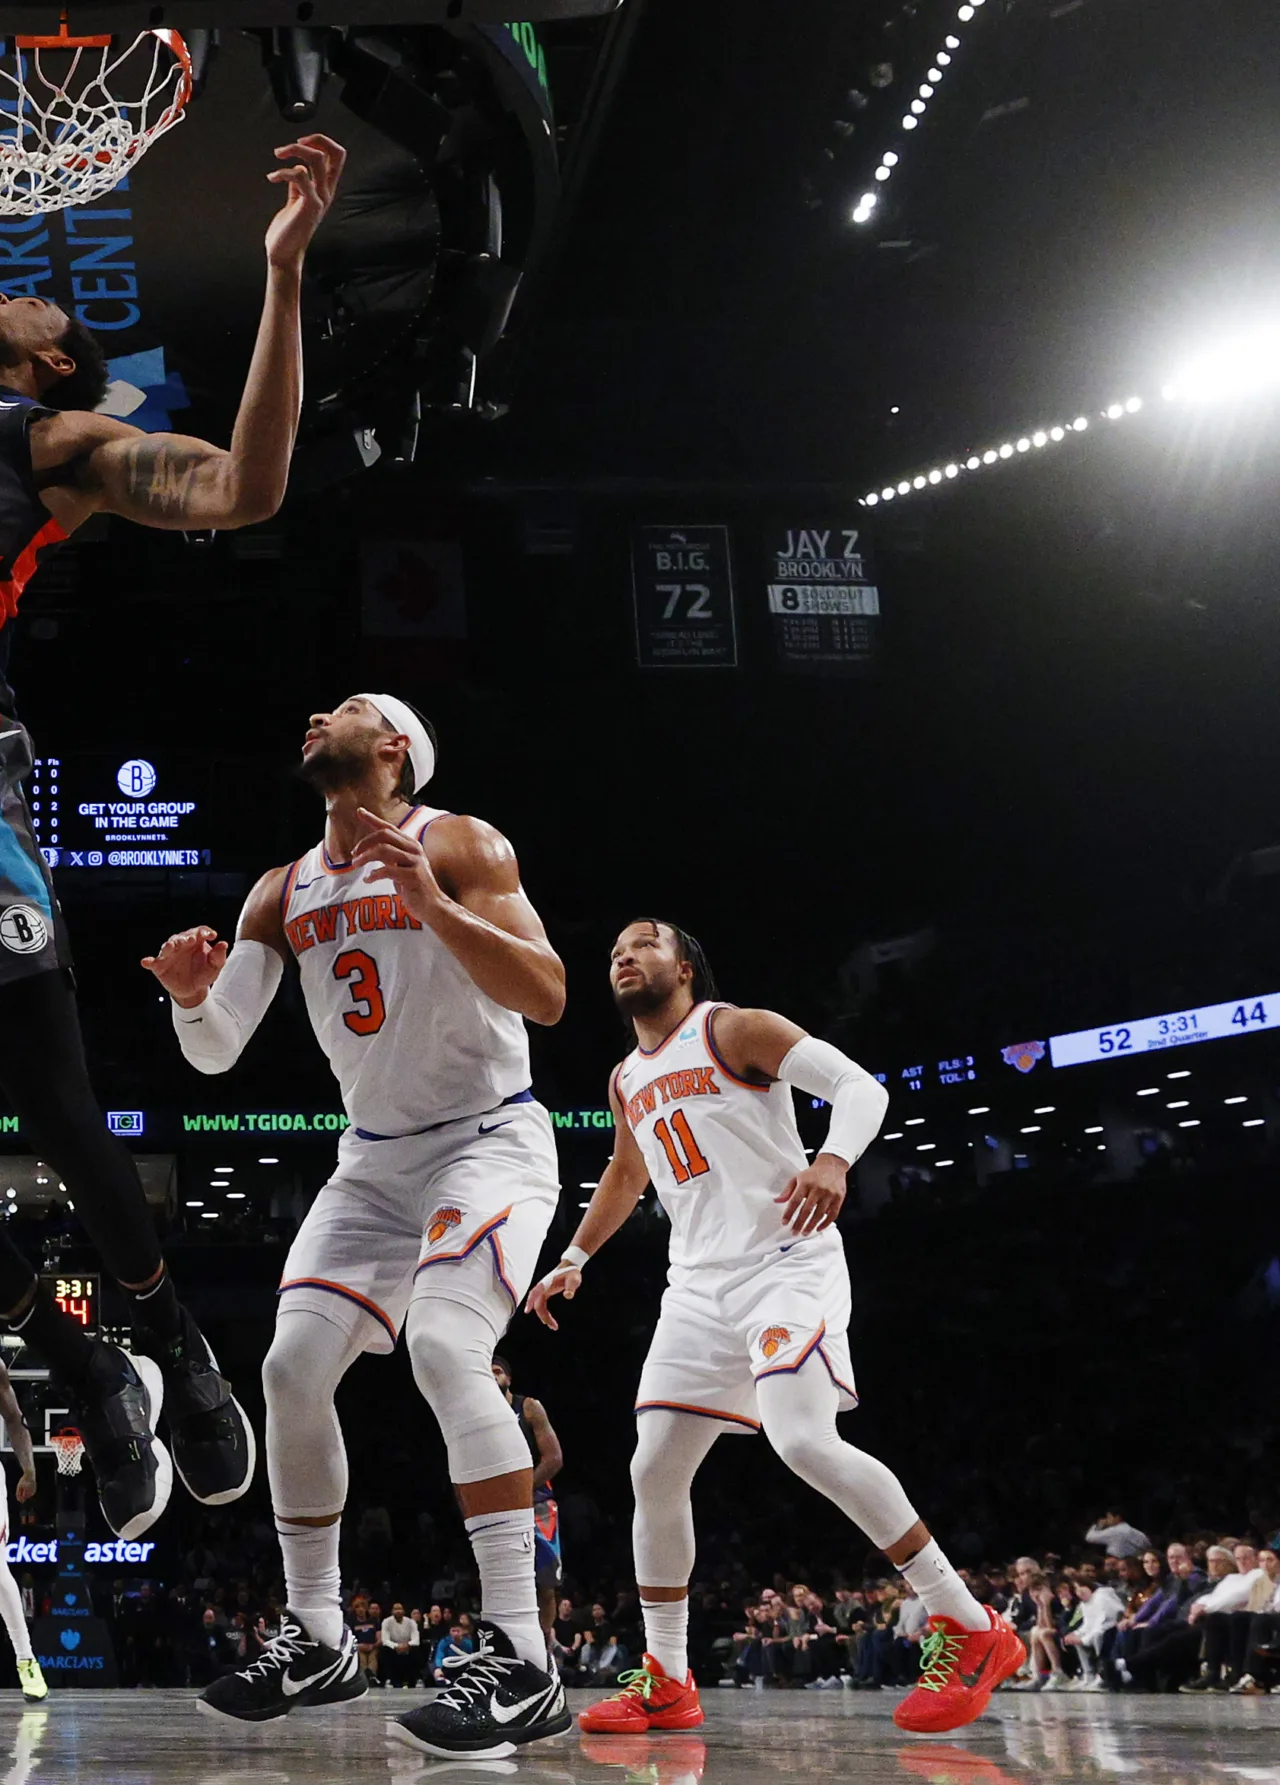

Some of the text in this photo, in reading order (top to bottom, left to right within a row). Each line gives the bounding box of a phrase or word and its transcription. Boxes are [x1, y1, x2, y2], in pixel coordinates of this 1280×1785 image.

[776, 530, 861, 558] JAY Z
[656, 552, 710, 571] B.I.G.
[778, 561, 863, 577] BROOKLYN
[655, 584, 713, 619] 72
[782, 588, 799, 610] 8
[34, 769, 58, 778] 1 0
[33, 786, 58, 795] 0 0
[33, 802, 58, 811] 0 2
[78, 803, 195, 815] GET YOUR GROUP
[33, 818, 58, 827] 0 0
[95, 816, 179, 828] IN THE GAME
[50, 834, 58, 843] 0
[108, 850, 199, 866] @BROOKLYNNETS
[284, 903, 338, 957] NEW
[332, 949, 386, 1037] 3
[1231, 1002, 1268, 1027] 44
[1158, 1014, 1199, 1035] 3:31
[1099, 1028, 1133, 1053] 52
[1170, 1030, 1208, 1044] Quarter
[966, 1056, 974, 1066] 3
[902, 1066, 923, 1078] AST
[909, 1080, 920, 1090] 11
[622, 1066, 722, 1131] NEW YORK
[653, 1108, 710, 1185] 11
[56, 1280, 92, 1297] 3:31
[38, 1656, 103, 1668] BARCLAYS
